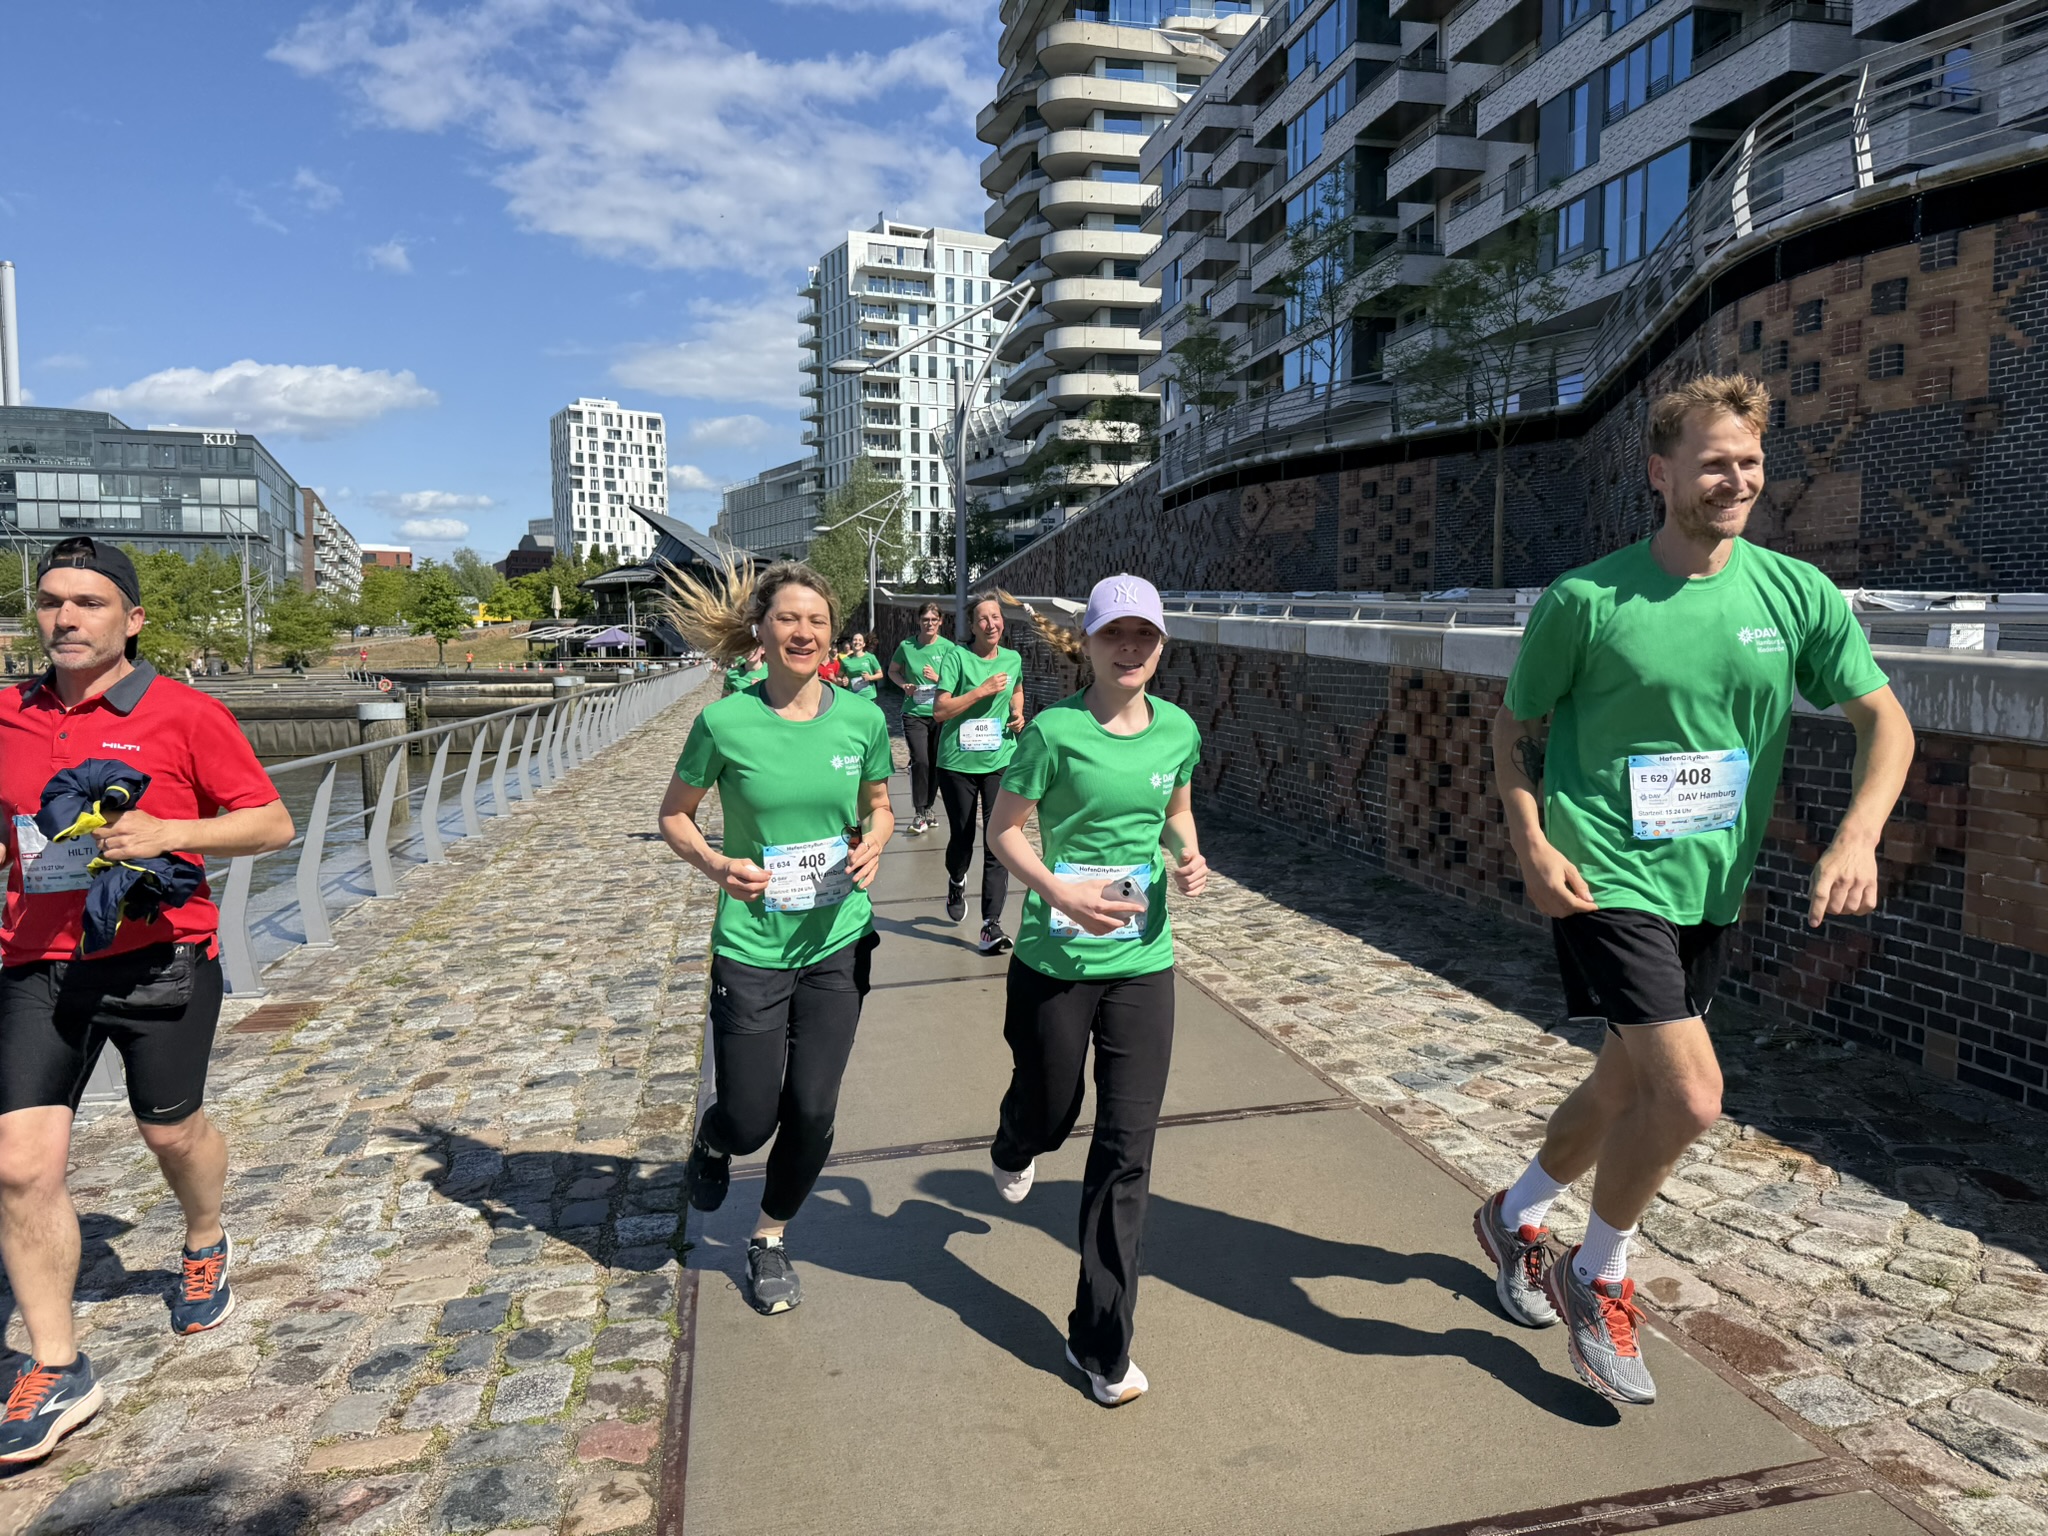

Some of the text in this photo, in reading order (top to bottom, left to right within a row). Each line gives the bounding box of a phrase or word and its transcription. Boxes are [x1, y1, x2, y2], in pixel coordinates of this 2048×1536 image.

[202, 433, 237, 446] KLU
[1113, 582, 1138, 604] NY
[1754, 627, 1777, 638] DAV
[102, 742, 140, 751] HILTI
[844, 755, 860, 764] DAV
[1659, 754, 1709, 762] HafenCityRun
[1651, 774, 1668, 782] 629
[1676, 768, 1711, 785] 408
[1678, 793, 1698, 802] DAV
[1700, 789, 1736, 800] Hamburg
[68, 847, 93, 857] HILTI
[787, 843, 823, 851] HafenCityRun
[798, 853, 826, 869] 408
[1079, 866, 1120, 874] HafenCityRun
